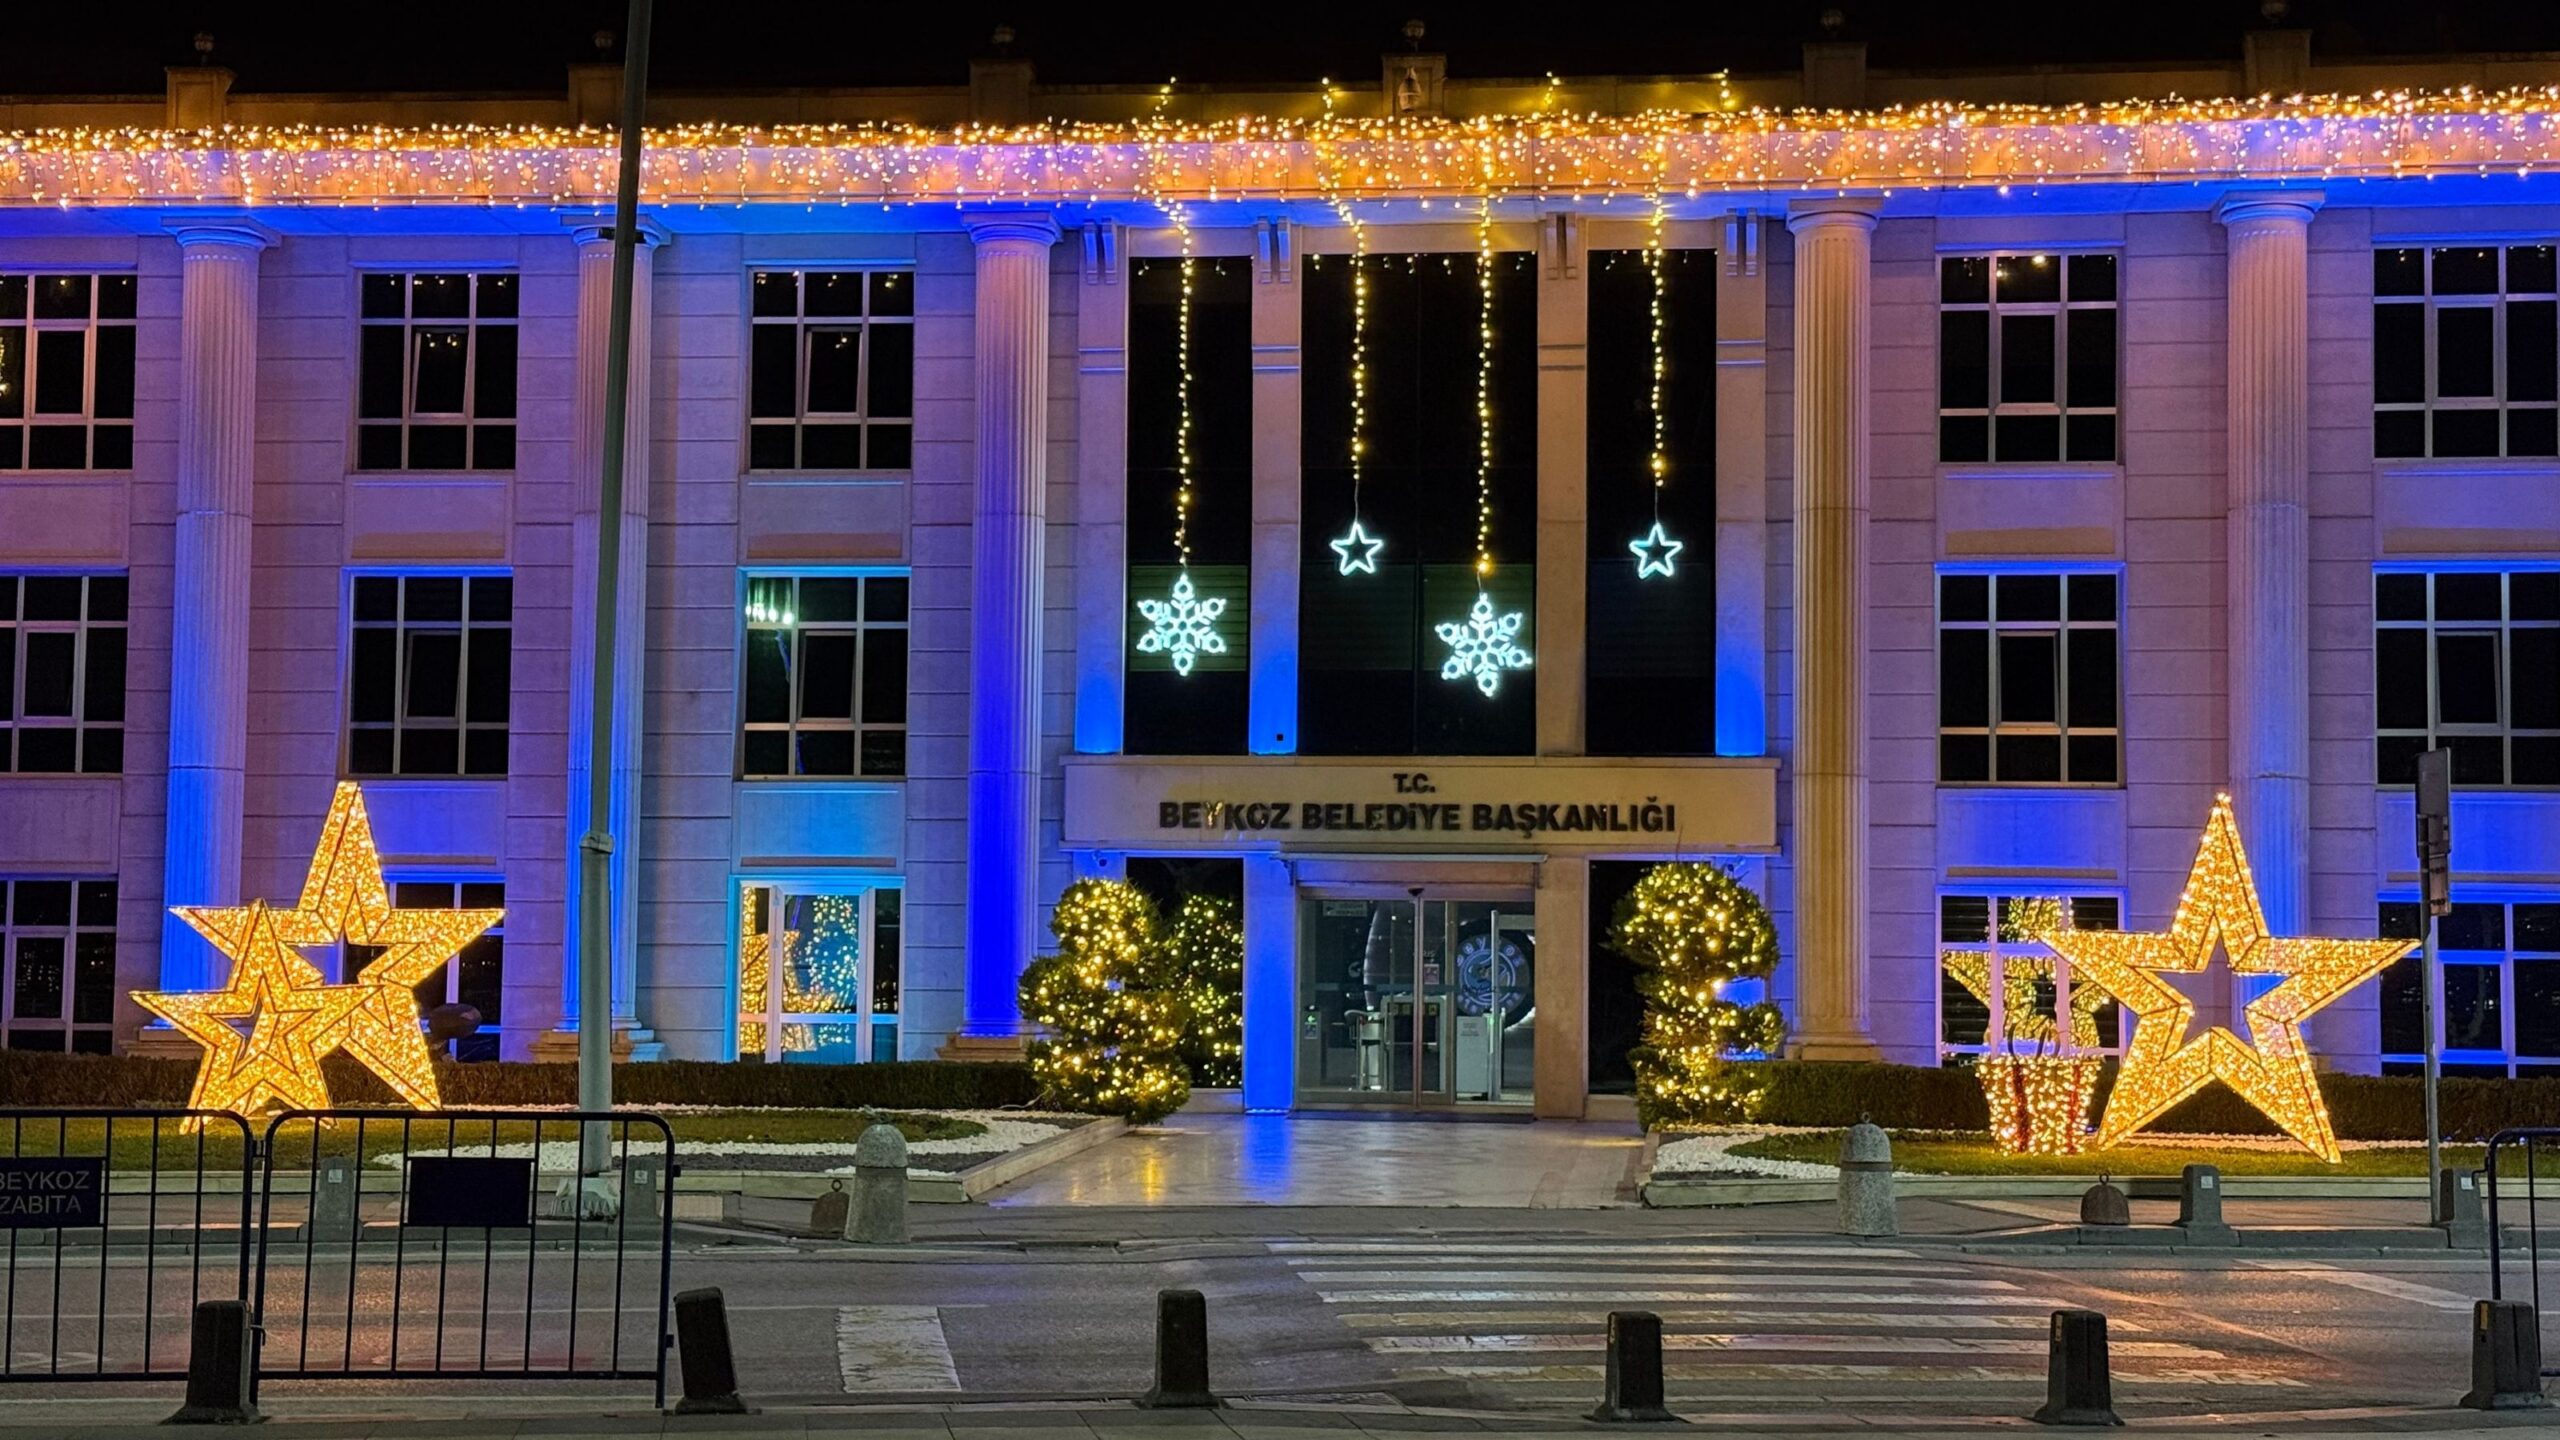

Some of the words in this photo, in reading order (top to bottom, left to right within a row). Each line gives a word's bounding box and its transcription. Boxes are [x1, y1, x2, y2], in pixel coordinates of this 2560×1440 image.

[1393, 773, 1436, 793] T.C.
[1159, 801, 1291, 831] BEYKOZ
[1472, 796, 1676, 839] BAŞKANLIĞI
[0, 1195, 82, 1214] ZABITA
